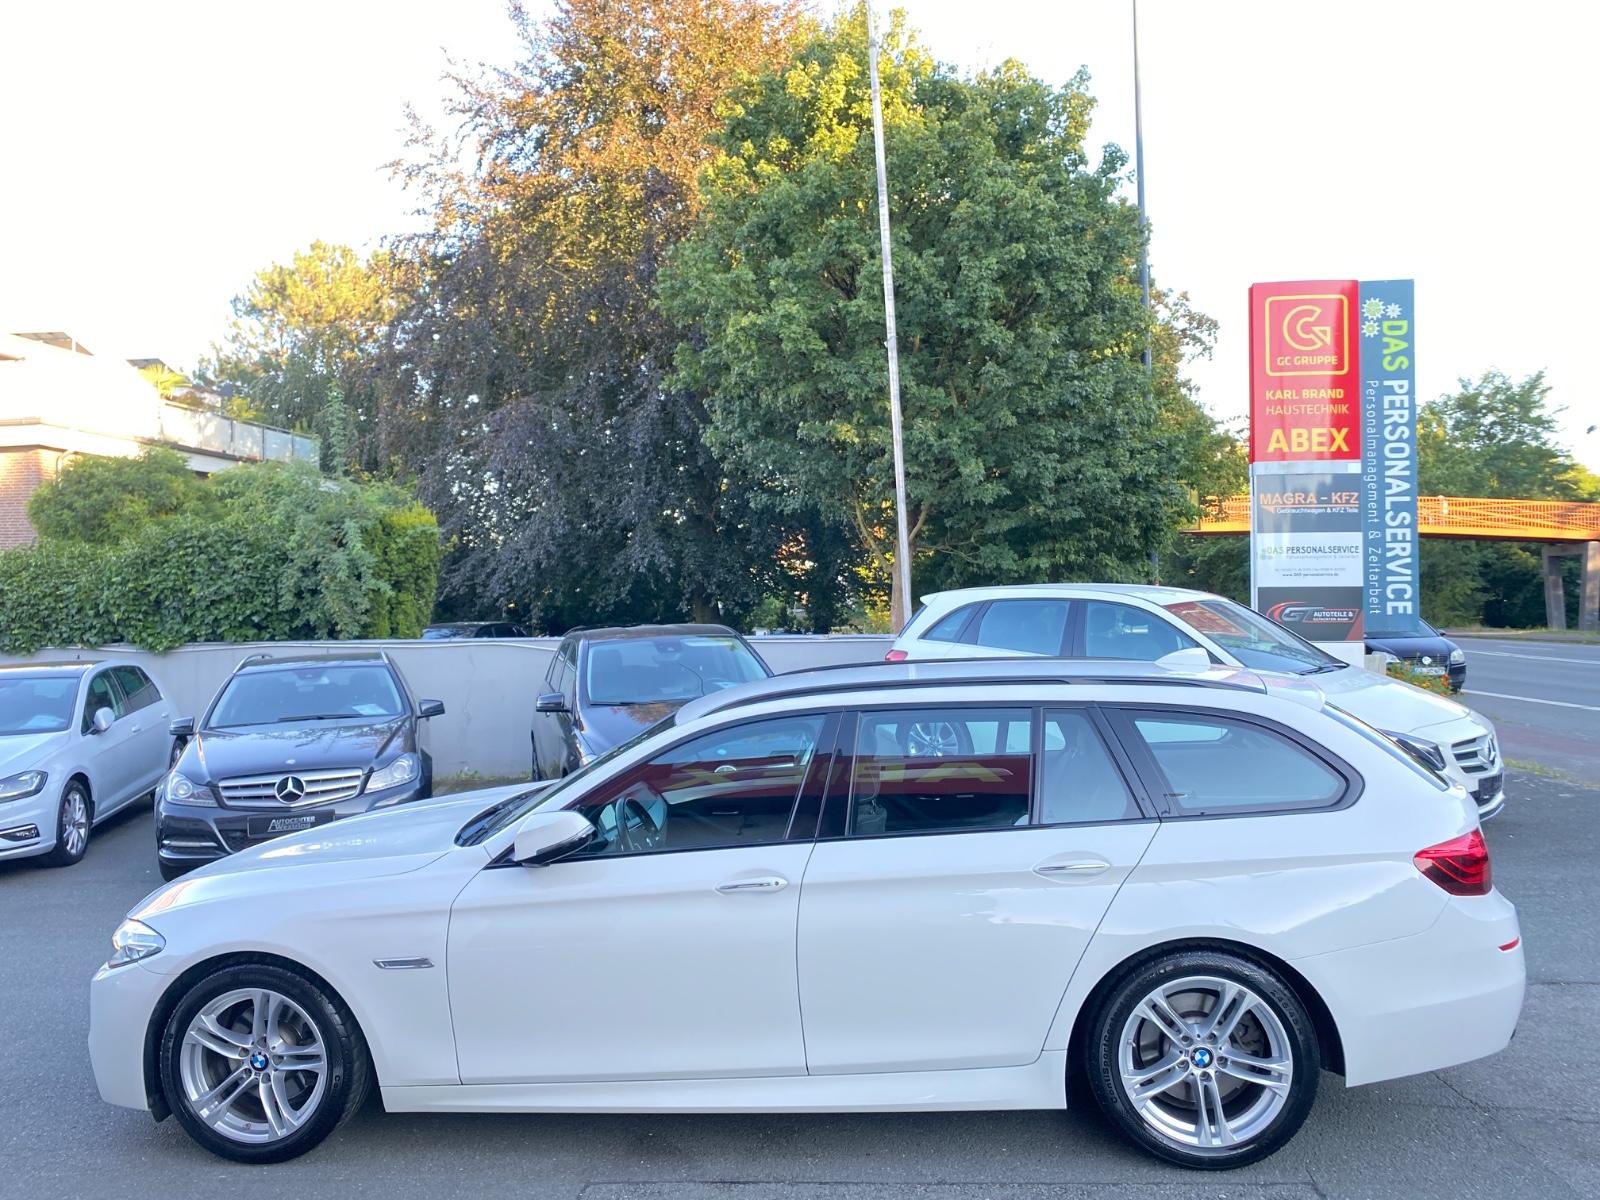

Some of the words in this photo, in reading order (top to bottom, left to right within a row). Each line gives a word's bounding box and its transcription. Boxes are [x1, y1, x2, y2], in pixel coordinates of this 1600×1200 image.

[1382, 320, 1409, 372] DAS
[1277, 356, 1291, 366] GC
[1294, 355, 1338, 366] GRUPPE
[1265, 389, 1299, 400] KARL
[1302, 388, 1344, 399] BRAND
[1265, 404, 1349, 415] HAUSTECHNIK
[1267, 427, 1350, 453] ABEX
[1363, 380, 1380, 523] Personalmanagement
[1260, 492, 1317, 505] MAGRA
[1331, 492, 1359, 504] KFZ
[1383, 379, 1412, 616] PERSONALSERVICE
[1368, 531, 1381, 539] &
[1286, 545, 1359, 554] PERSONALSERVICE
[1368, 547, 1383, 614] Zeitarbeit
